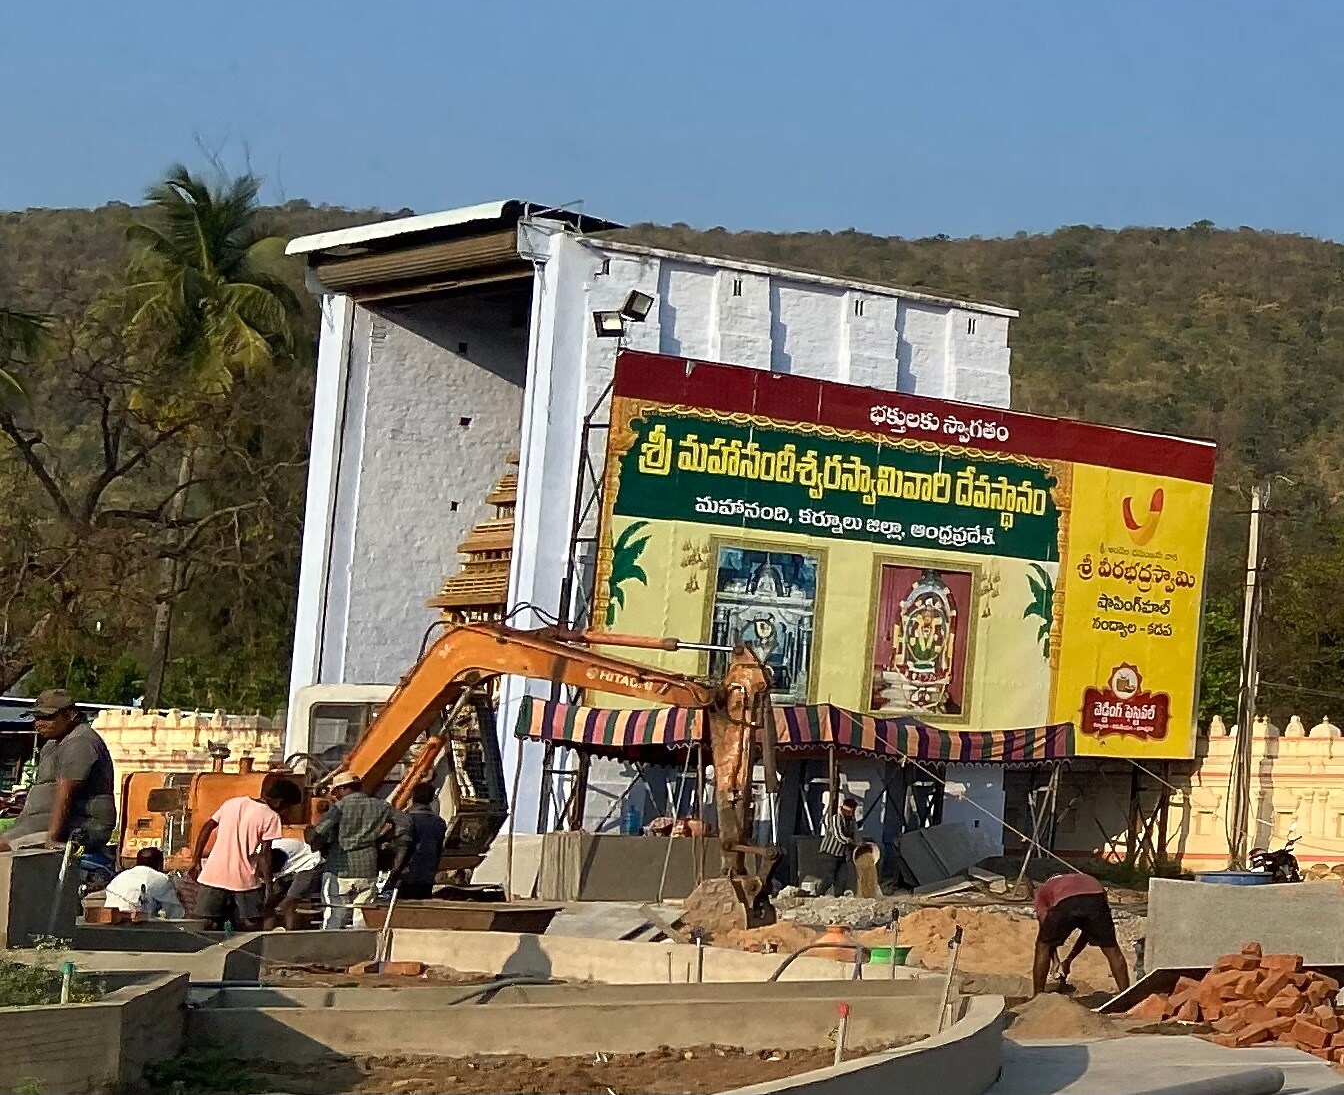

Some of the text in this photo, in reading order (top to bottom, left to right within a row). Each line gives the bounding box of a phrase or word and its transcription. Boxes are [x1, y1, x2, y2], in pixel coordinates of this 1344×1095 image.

[869, 404, 1010, 443] భక్తులకు స్వాగతం
[638, 424, 673, 476] శ్రీ
[798, 507, 863, 535] కర్నూలు
[910, 522, 996, 547] ఆంధ్రప్రదేశ్
[1076, 553, 1196, 594] శ్రీ వీరభద్రస్వామి
[1091, 616, 1138, 638] నంద్యాల
[1146, 622, 1174, 637] కడప
